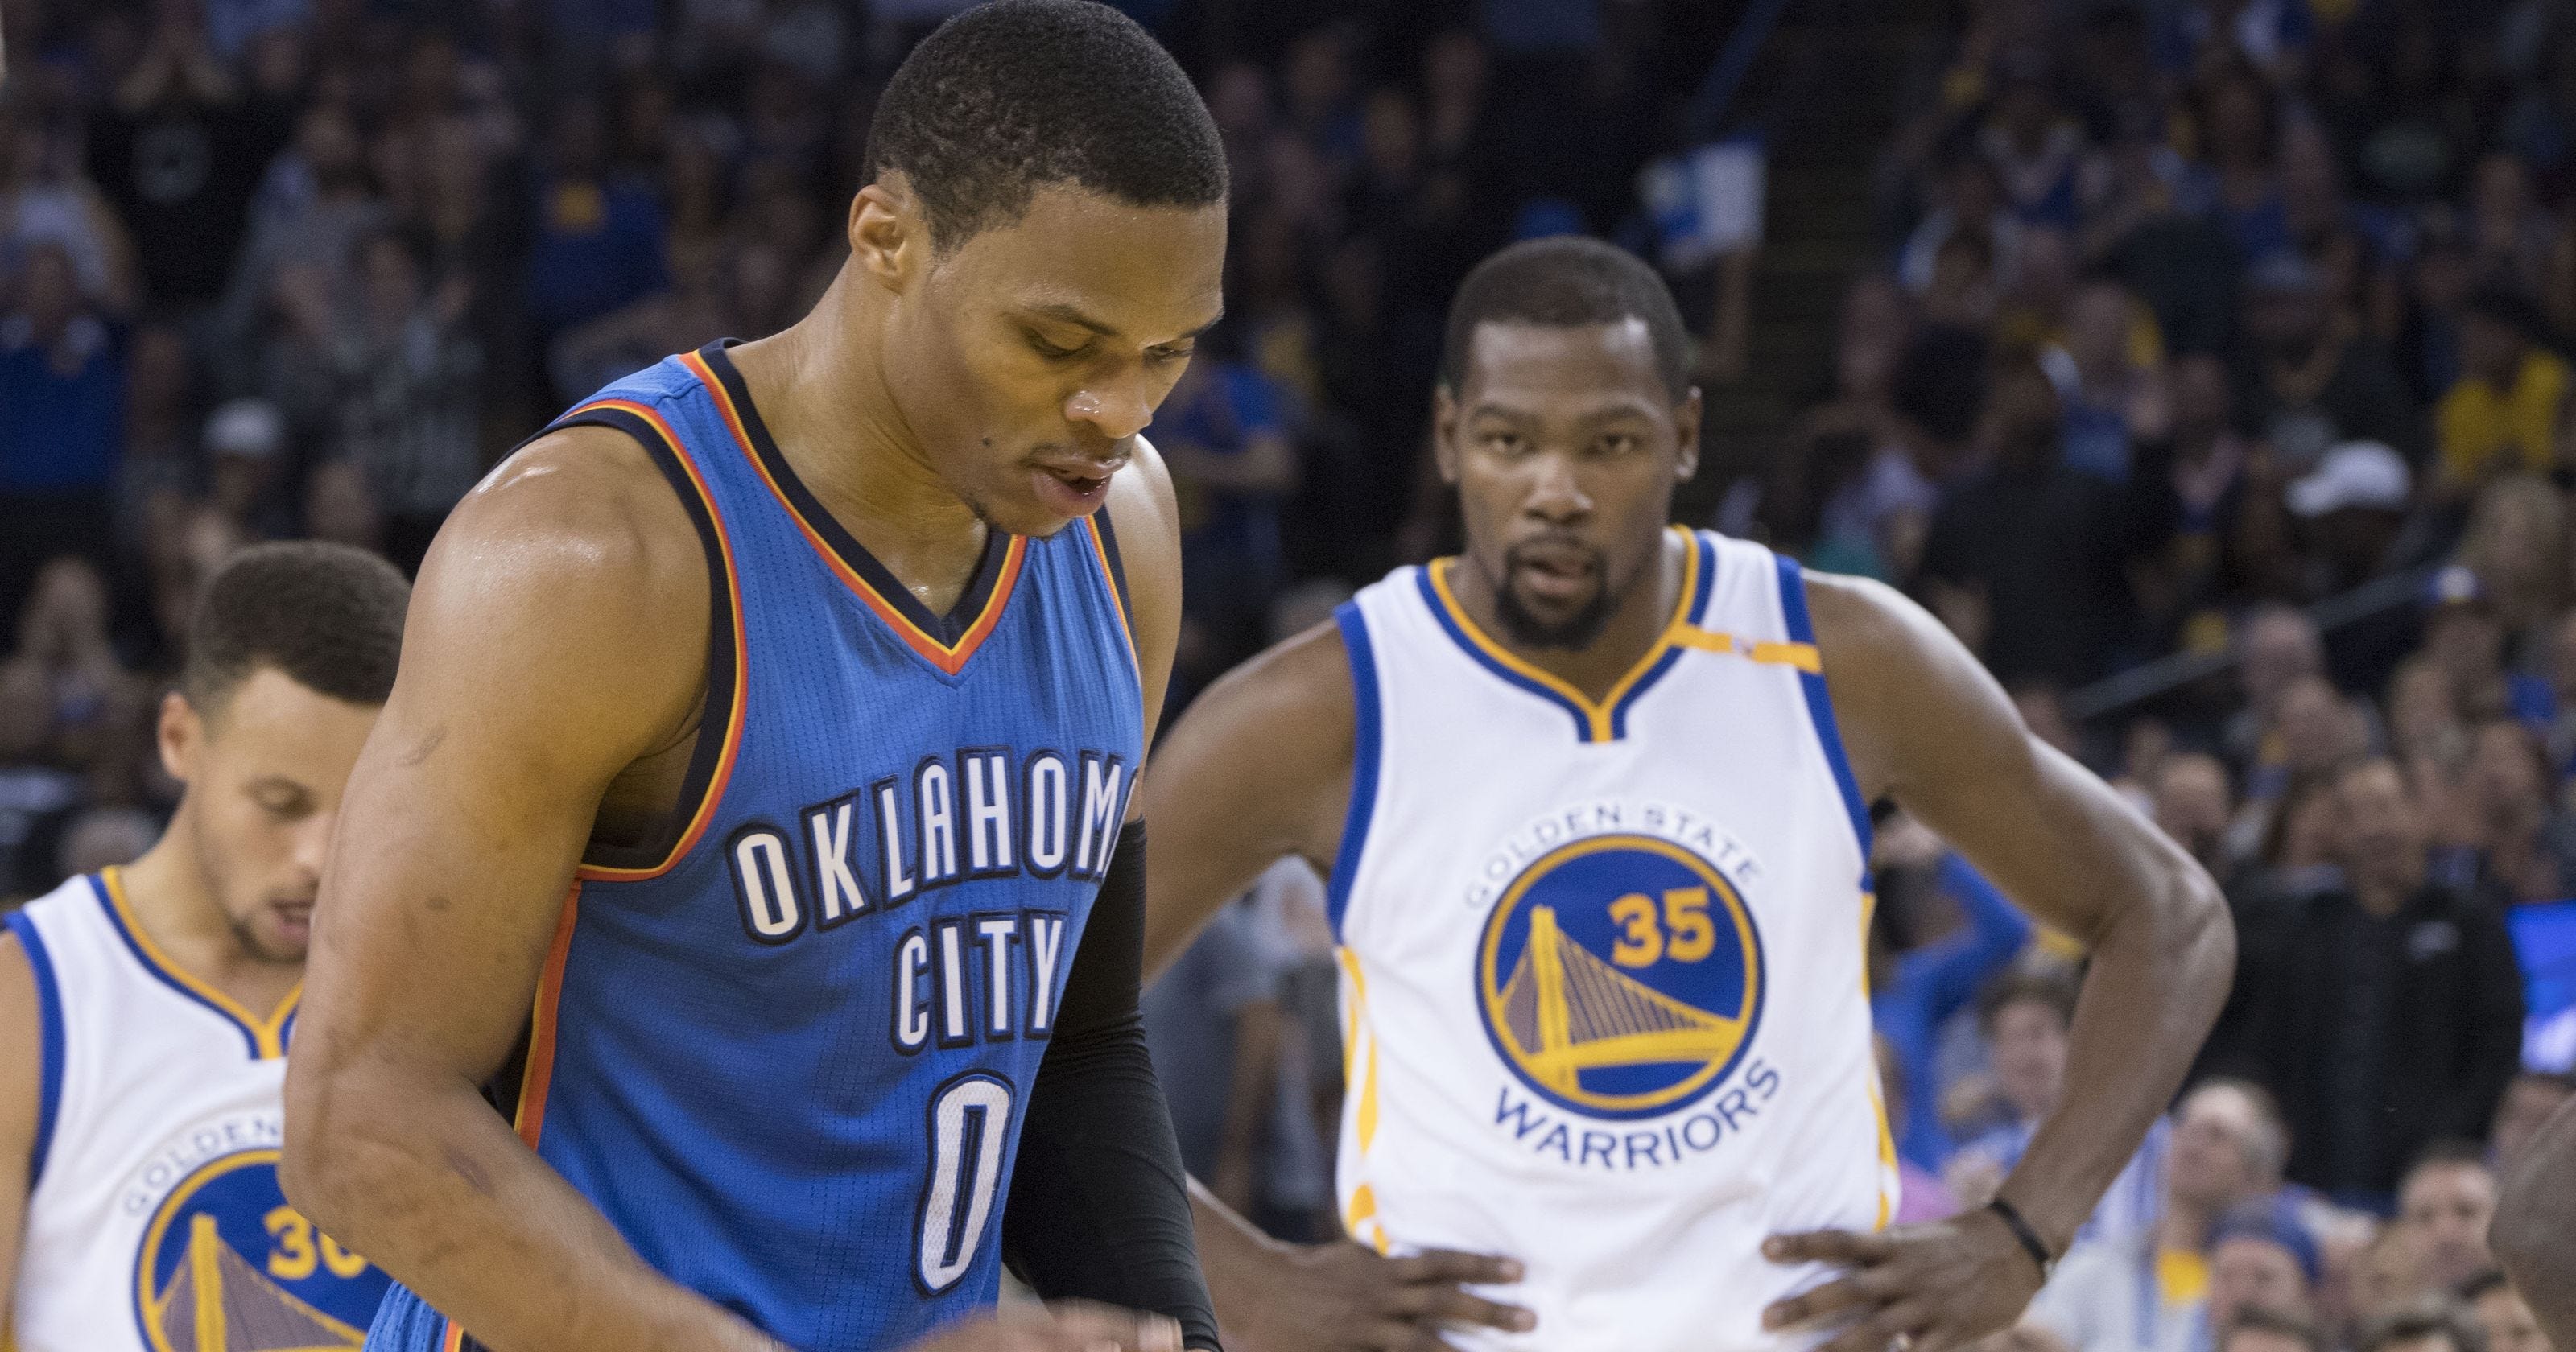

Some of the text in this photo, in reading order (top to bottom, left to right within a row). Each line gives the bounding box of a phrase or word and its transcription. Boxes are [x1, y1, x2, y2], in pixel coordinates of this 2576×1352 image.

[727, 745, 1140, 946] OKLAHOM
[1463, 803, 1762, 908] GOLDEN STATE
[891, 909, 1069, 1056] CITY
[1608, 885, 1716, 969] 35
[1495, 1058, 1780, 1170] WARRIORS
[911, 1068, 1016, 1299] 0
